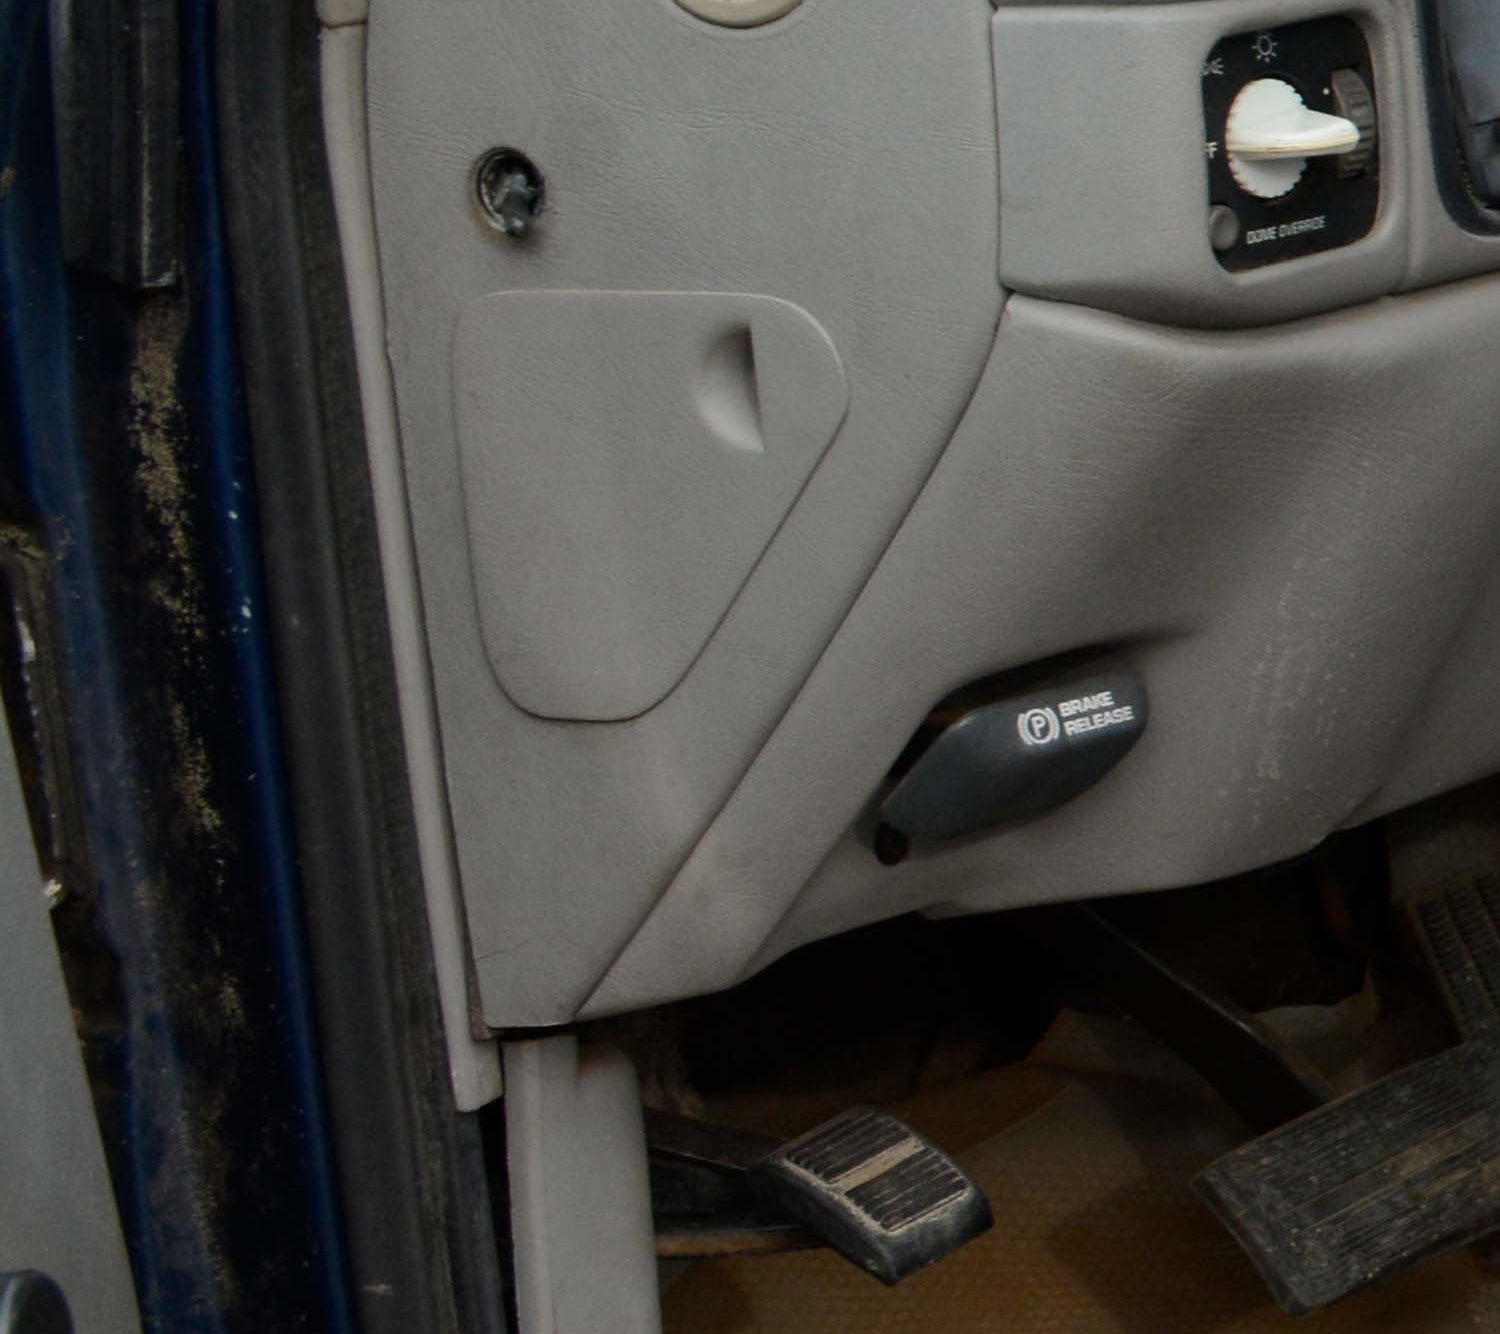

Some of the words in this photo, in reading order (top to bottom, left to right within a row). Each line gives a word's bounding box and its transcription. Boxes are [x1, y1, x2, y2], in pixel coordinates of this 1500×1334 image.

[1246, 227, 1277, 244] DOME
[1279, 216, 1326, 237] OVERRIDE
[1058, 691, 1115, 718] BRAKE
[1063, 706, 1134, 736] RELEASE
